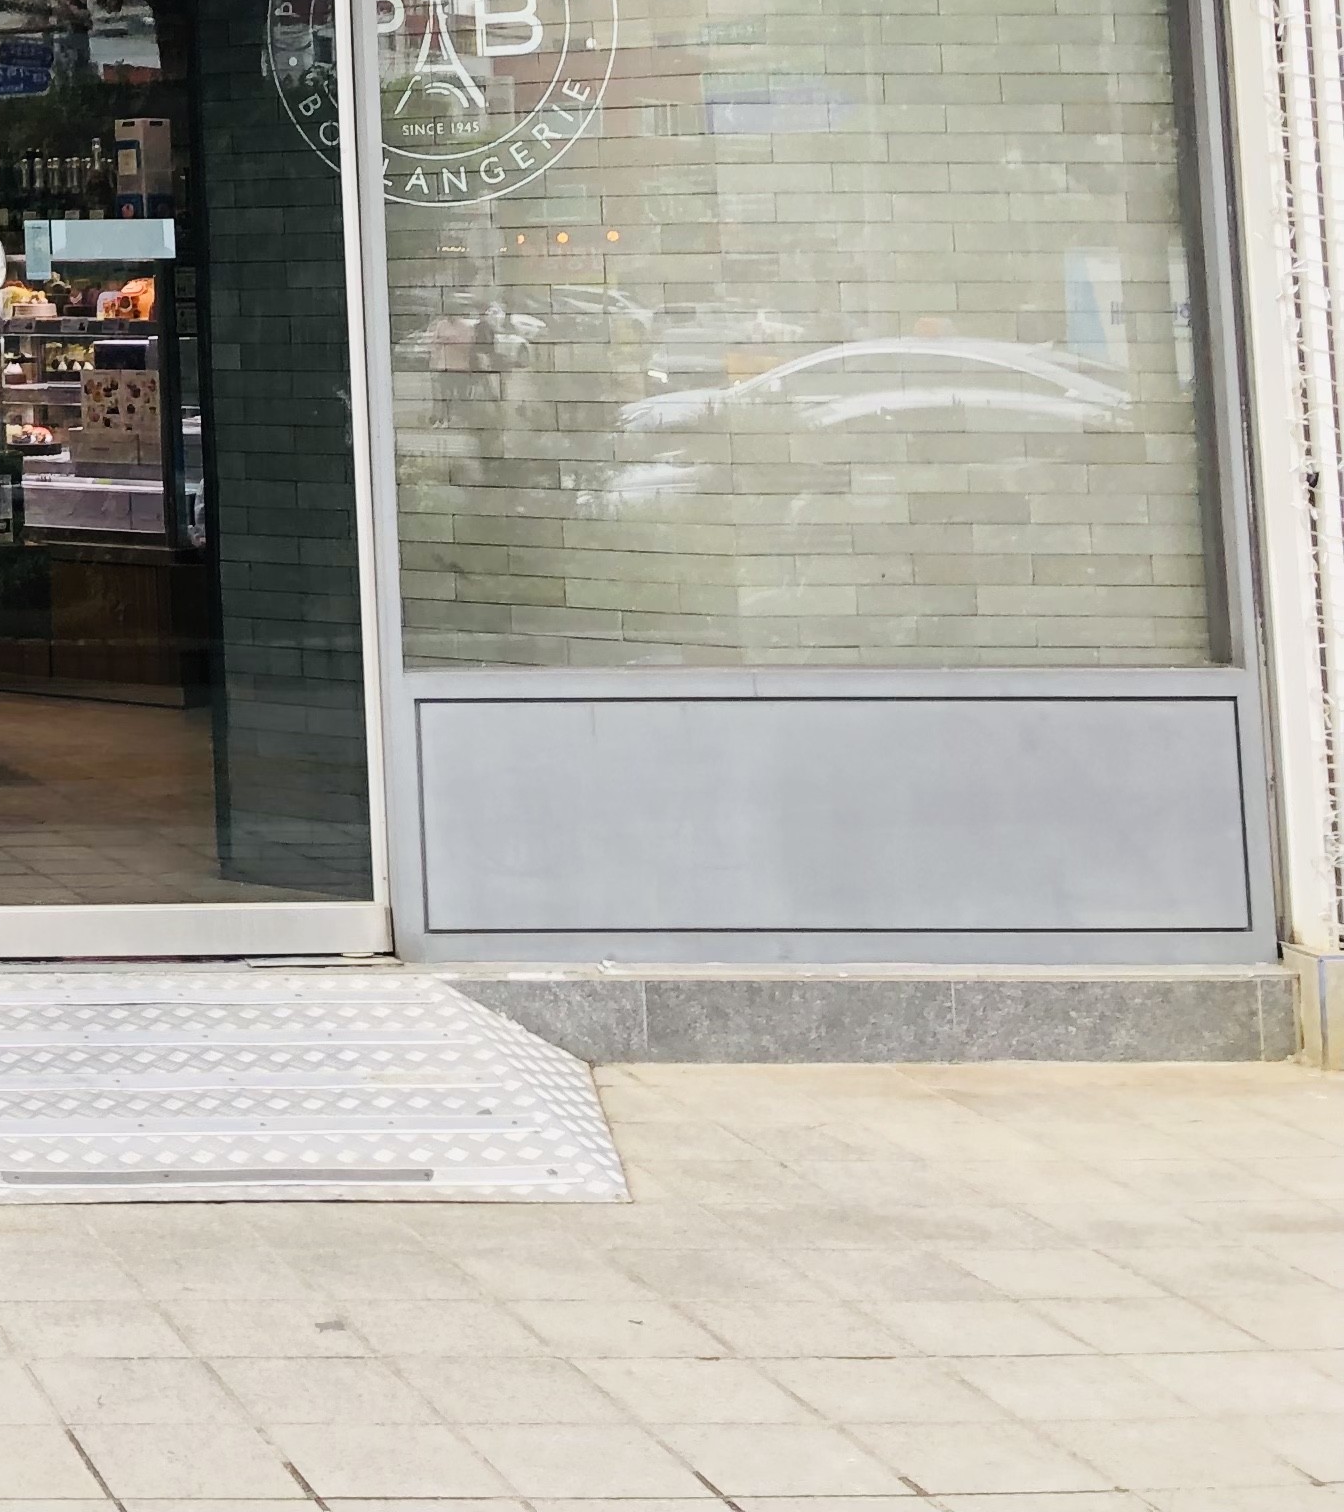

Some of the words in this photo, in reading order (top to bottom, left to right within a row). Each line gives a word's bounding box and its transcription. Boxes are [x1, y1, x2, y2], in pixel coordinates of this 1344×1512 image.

[298, 77, 593, 194] BOLANGERIE
[401, 123, 445, 137] SINCE
[450, 120, 480, 135] 1945
